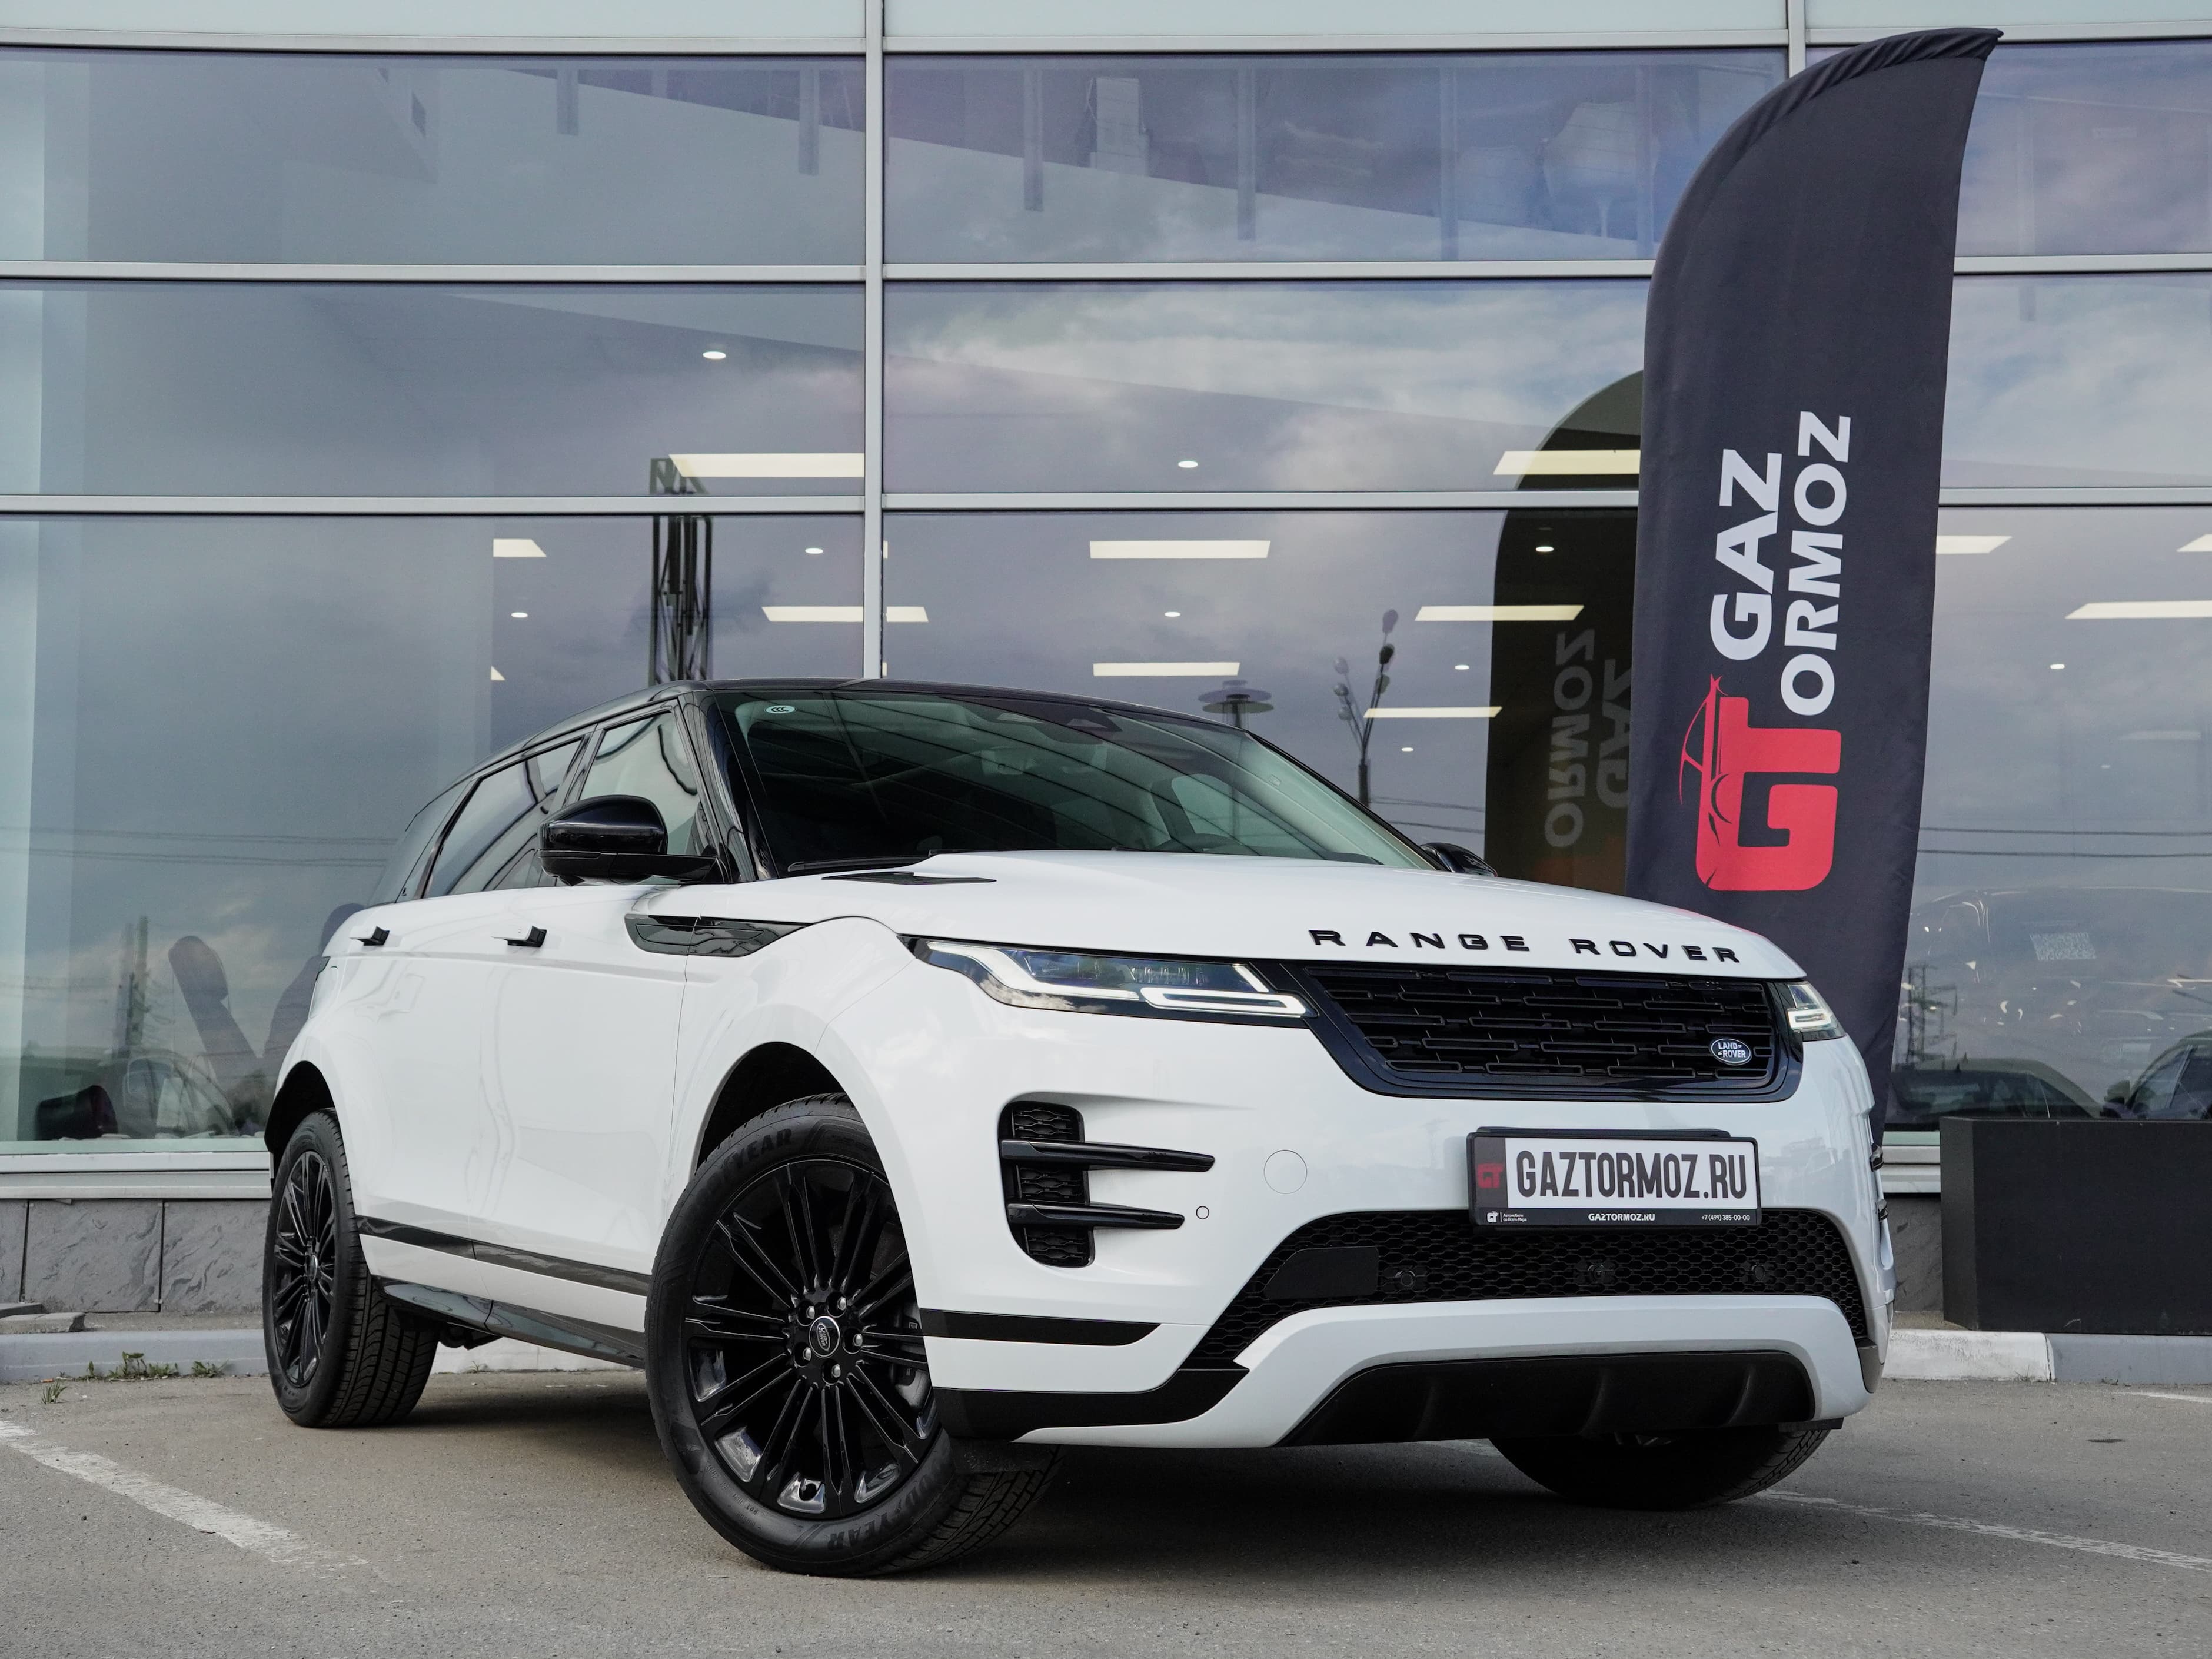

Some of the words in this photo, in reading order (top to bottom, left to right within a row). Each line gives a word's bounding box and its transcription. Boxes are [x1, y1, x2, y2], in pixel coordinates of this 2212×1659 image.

[1709, 448, 1782, 661] GAZ
[1781, 411, 1851, 716] ORMOZ
[1308, 930, 1530, 952] RANGE
[1568, 938, 1740, 964] ROVER
[1718, 1042, 1738, 1050] LAND
[1516, 1150, 1747, 1199] GAZTORMOZ.RU
